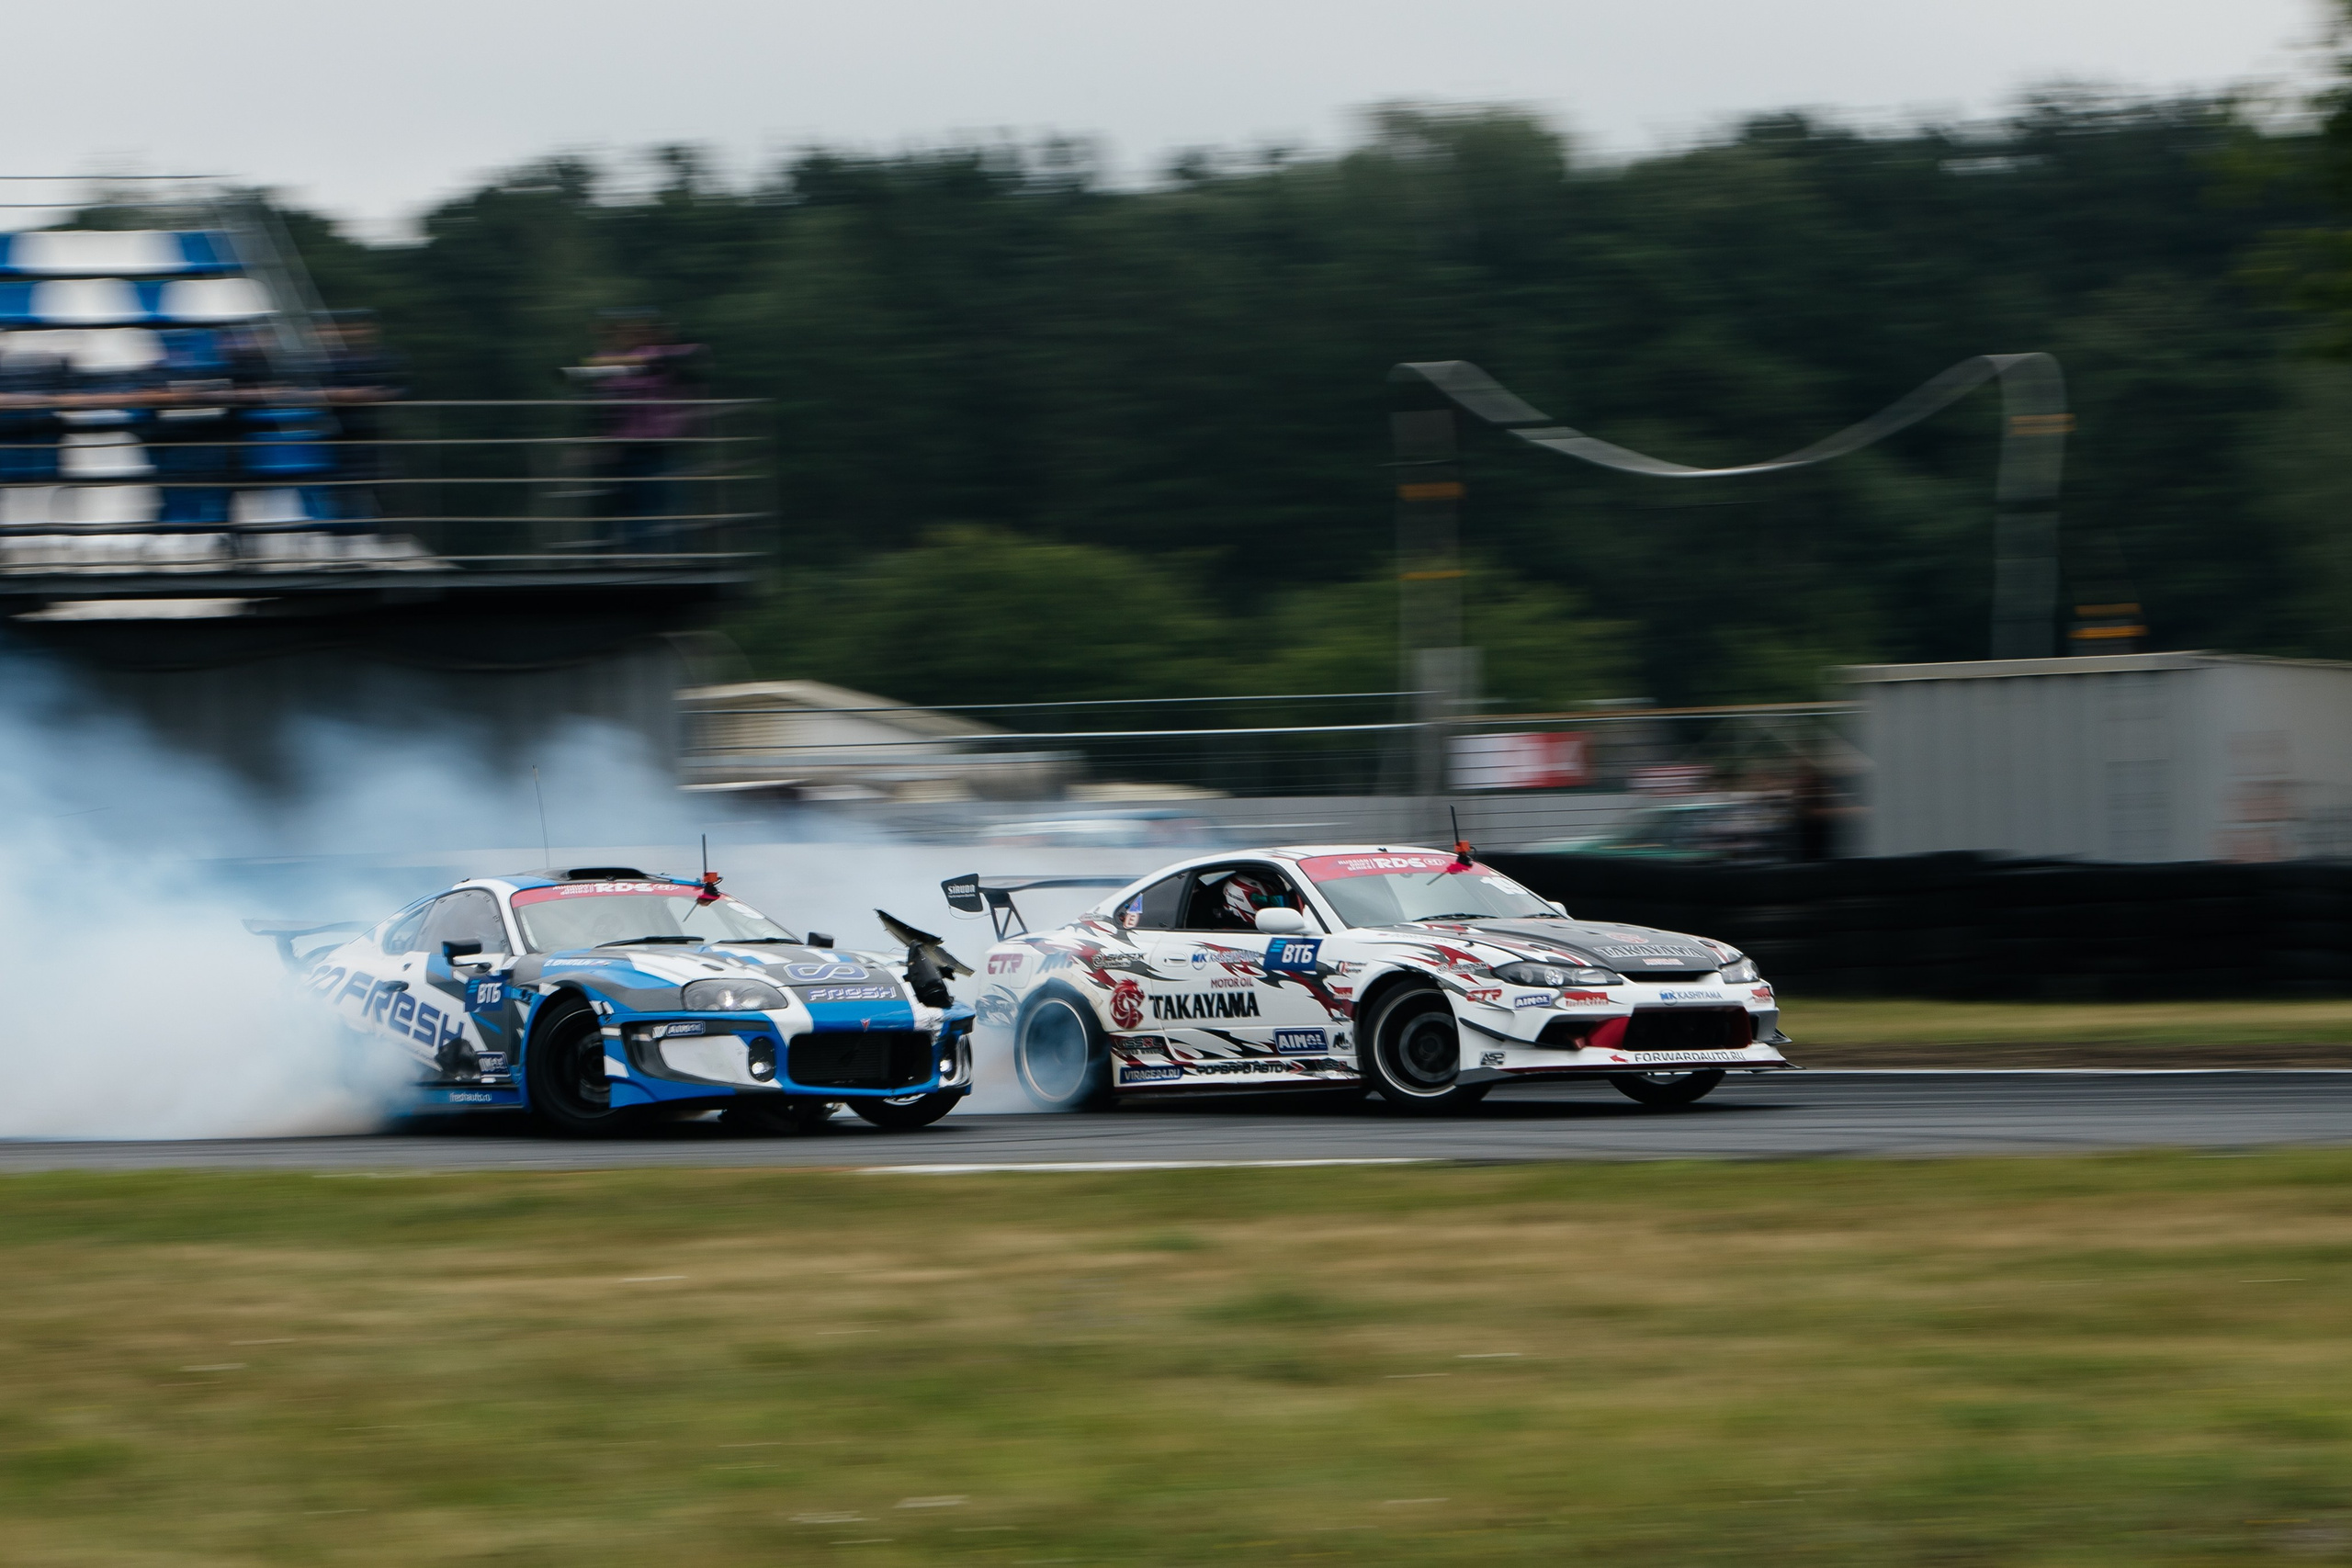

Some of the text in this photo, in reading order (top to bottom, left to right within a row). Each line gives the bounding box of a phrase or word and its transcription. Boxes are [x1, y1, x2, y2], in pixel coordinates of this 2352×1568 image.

[1374, 857, 1428, 869] RDS
[594, 883, 654, 893] RDS
[1282, 943, 1316, 964] ВТБ
[1593, 944, 1708, 959] TAKAYAMA
[1210, 976, 1254, 988] MOTOR OIL
[477, 982, 503, 1004] ВТБ
[1677, 990, 1724, 1000] KASHIYAMA
[1148, 992, 1261, 1021] TAKAYAMA
[1279, 1033, 1326, 1049] AIMOL
[1634, 1052, 1747, 1063] FORWARDAUTO.RU
[1125, 1068, 1180, 1080] VIRAGE24.RU
